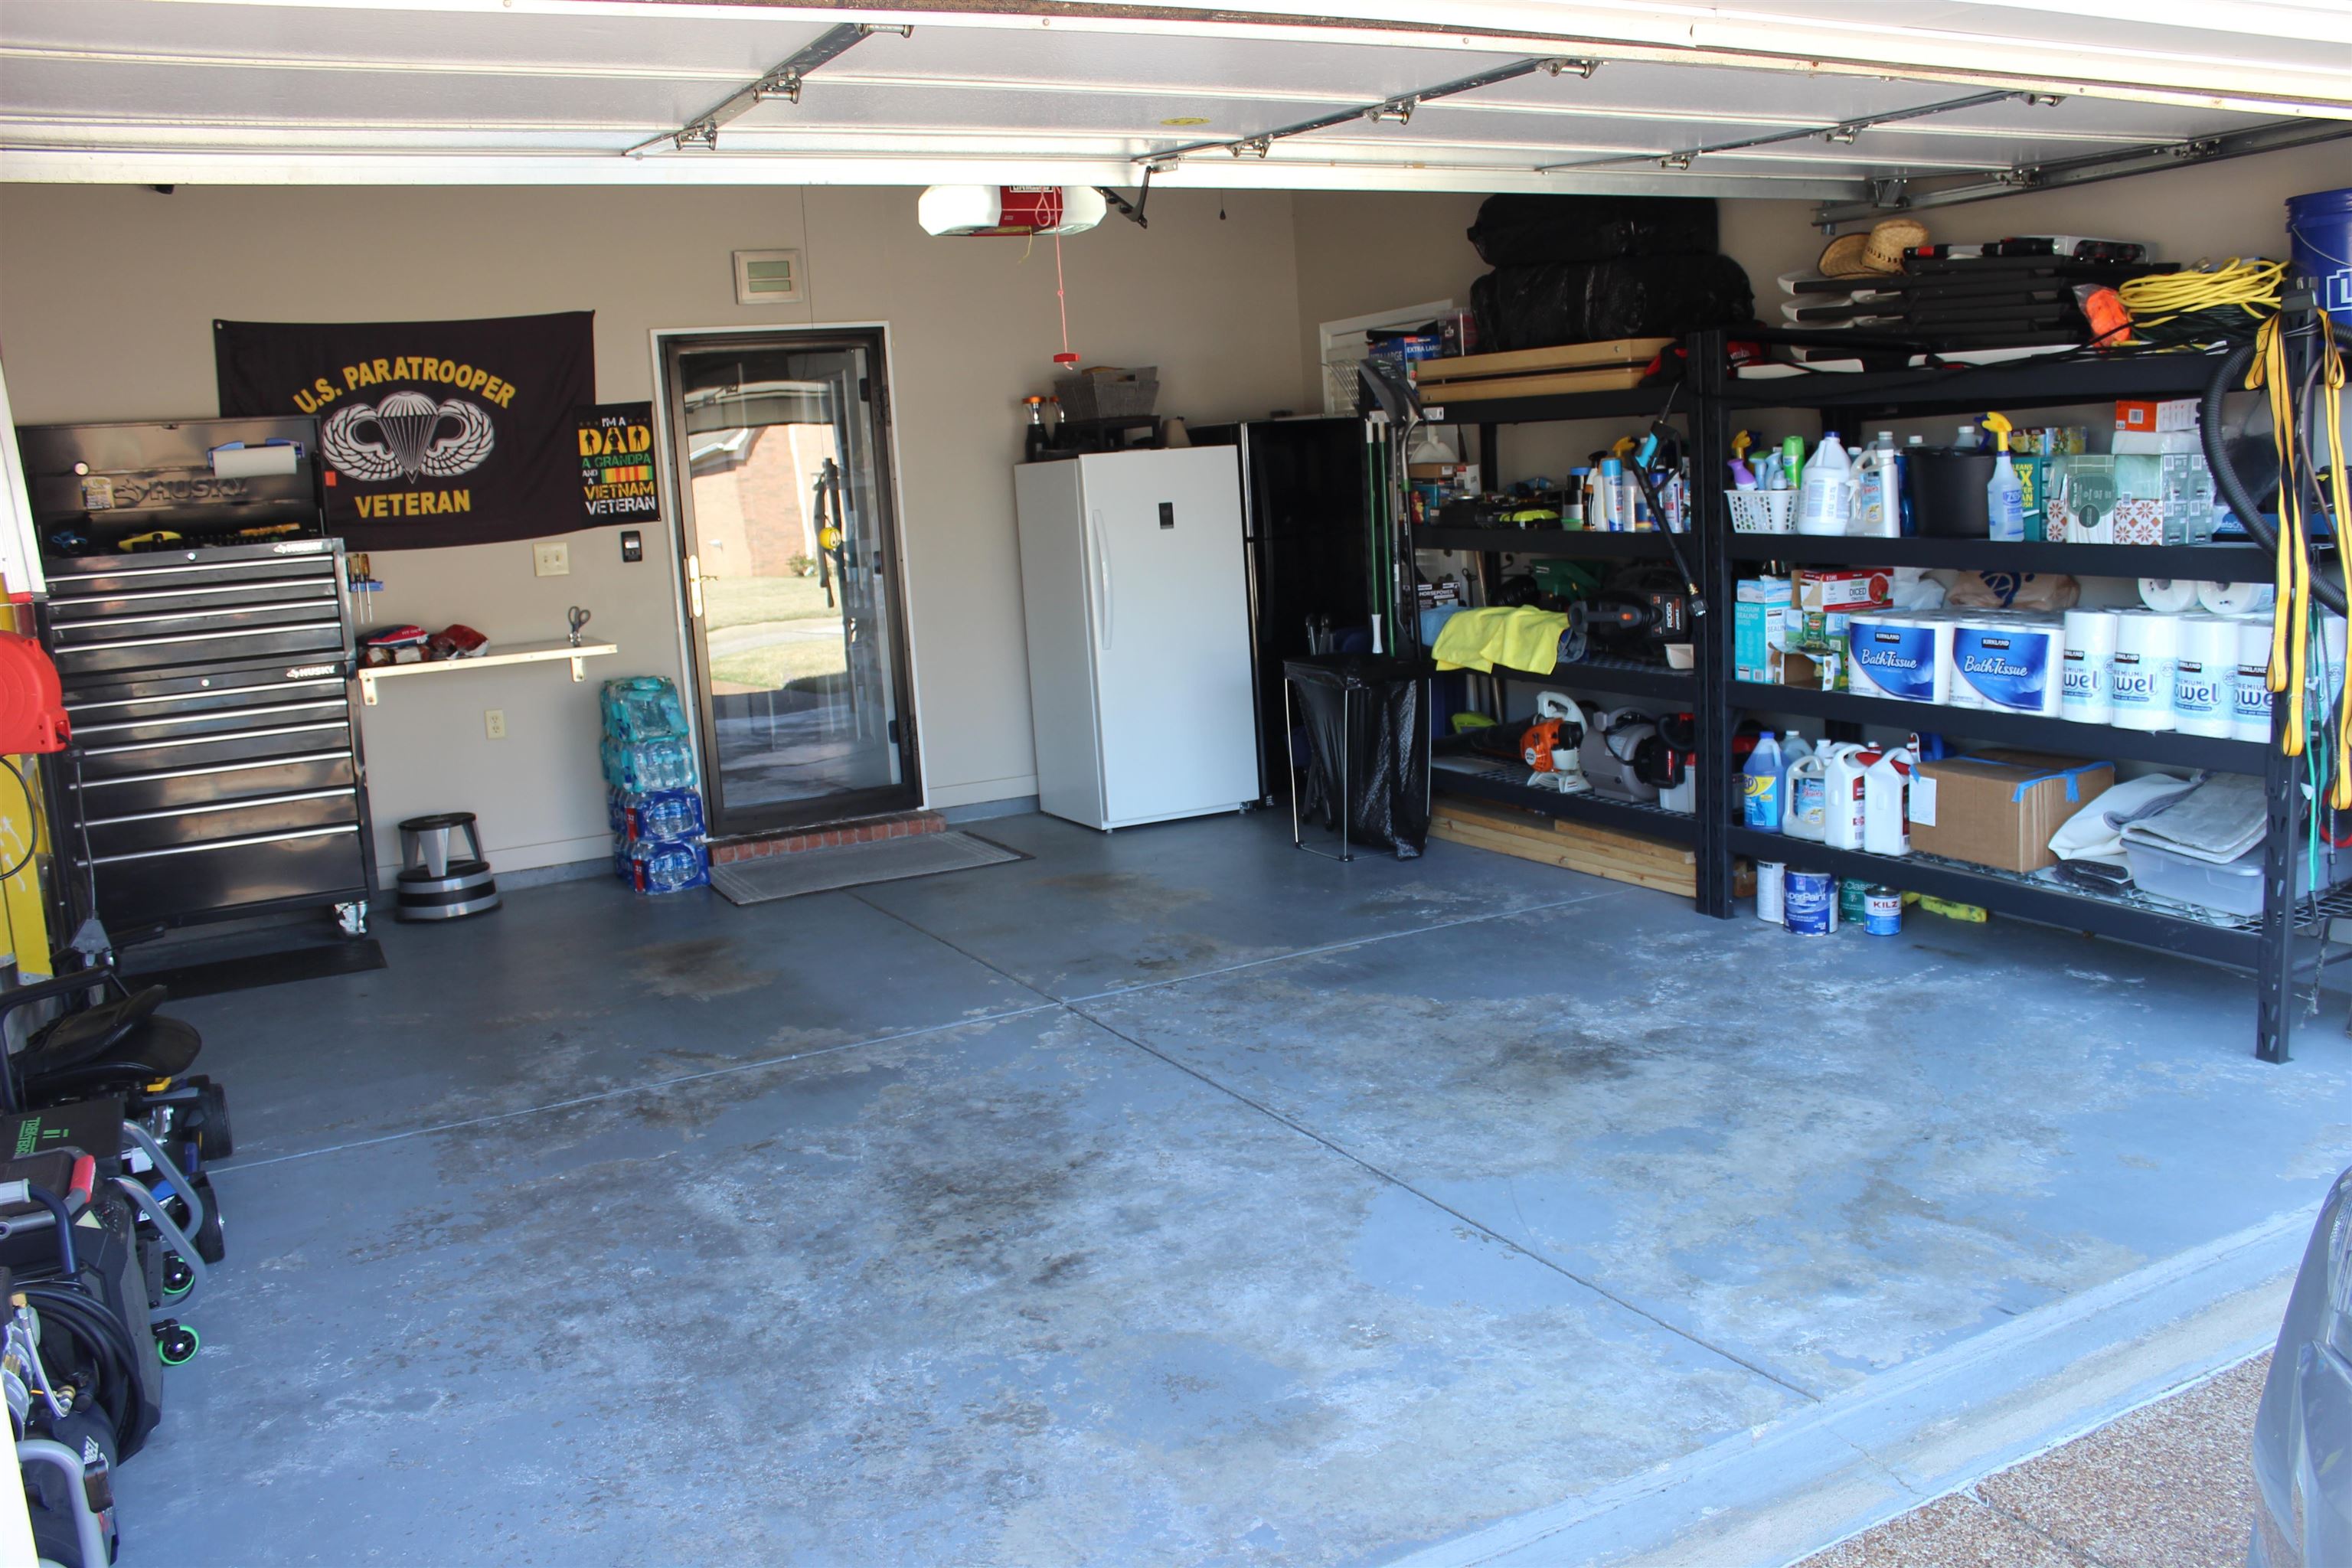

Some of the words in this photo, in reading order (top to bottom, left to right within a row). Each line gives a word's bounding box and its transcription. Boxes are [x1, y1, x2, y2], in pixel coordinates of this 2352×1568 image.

[292, 377, 342, 414] U.S.
[342, 356, 516, 409] PARATROOPER
[601, 417, 616, 427] I'M
[619, 416, 626, 426] A
[578, 425, 651, 456] DAD
[582, 457, 591, 469] A
[594, 453, 652, 467] GRANDPA
[582, 469, 599, 477] AND
[583, 482, 655, 501] VIETNAM
[354, 488, 470, 518] VETERAN
[585, 496, 655, 515] VETERAN
[1849, 588, 1867, 596] DICED
[1767, 624, 1788, 632] SEALIN
[1861, 648, 1887, 665] Bath
[1886, 651, 1917, 669] Tissue
[1965, 655, 1994, 672] Bath
[1994, 658, 2028, 677] Tissue
[298, 665, 335, 678] HUSKY
[2064, 671, 2098, 689] wel
[2113, 674, 2154, 694] wel
[1873, 900, 1899, 909] KILZ
[15, 1116, 41, 1155] TREKTERR
